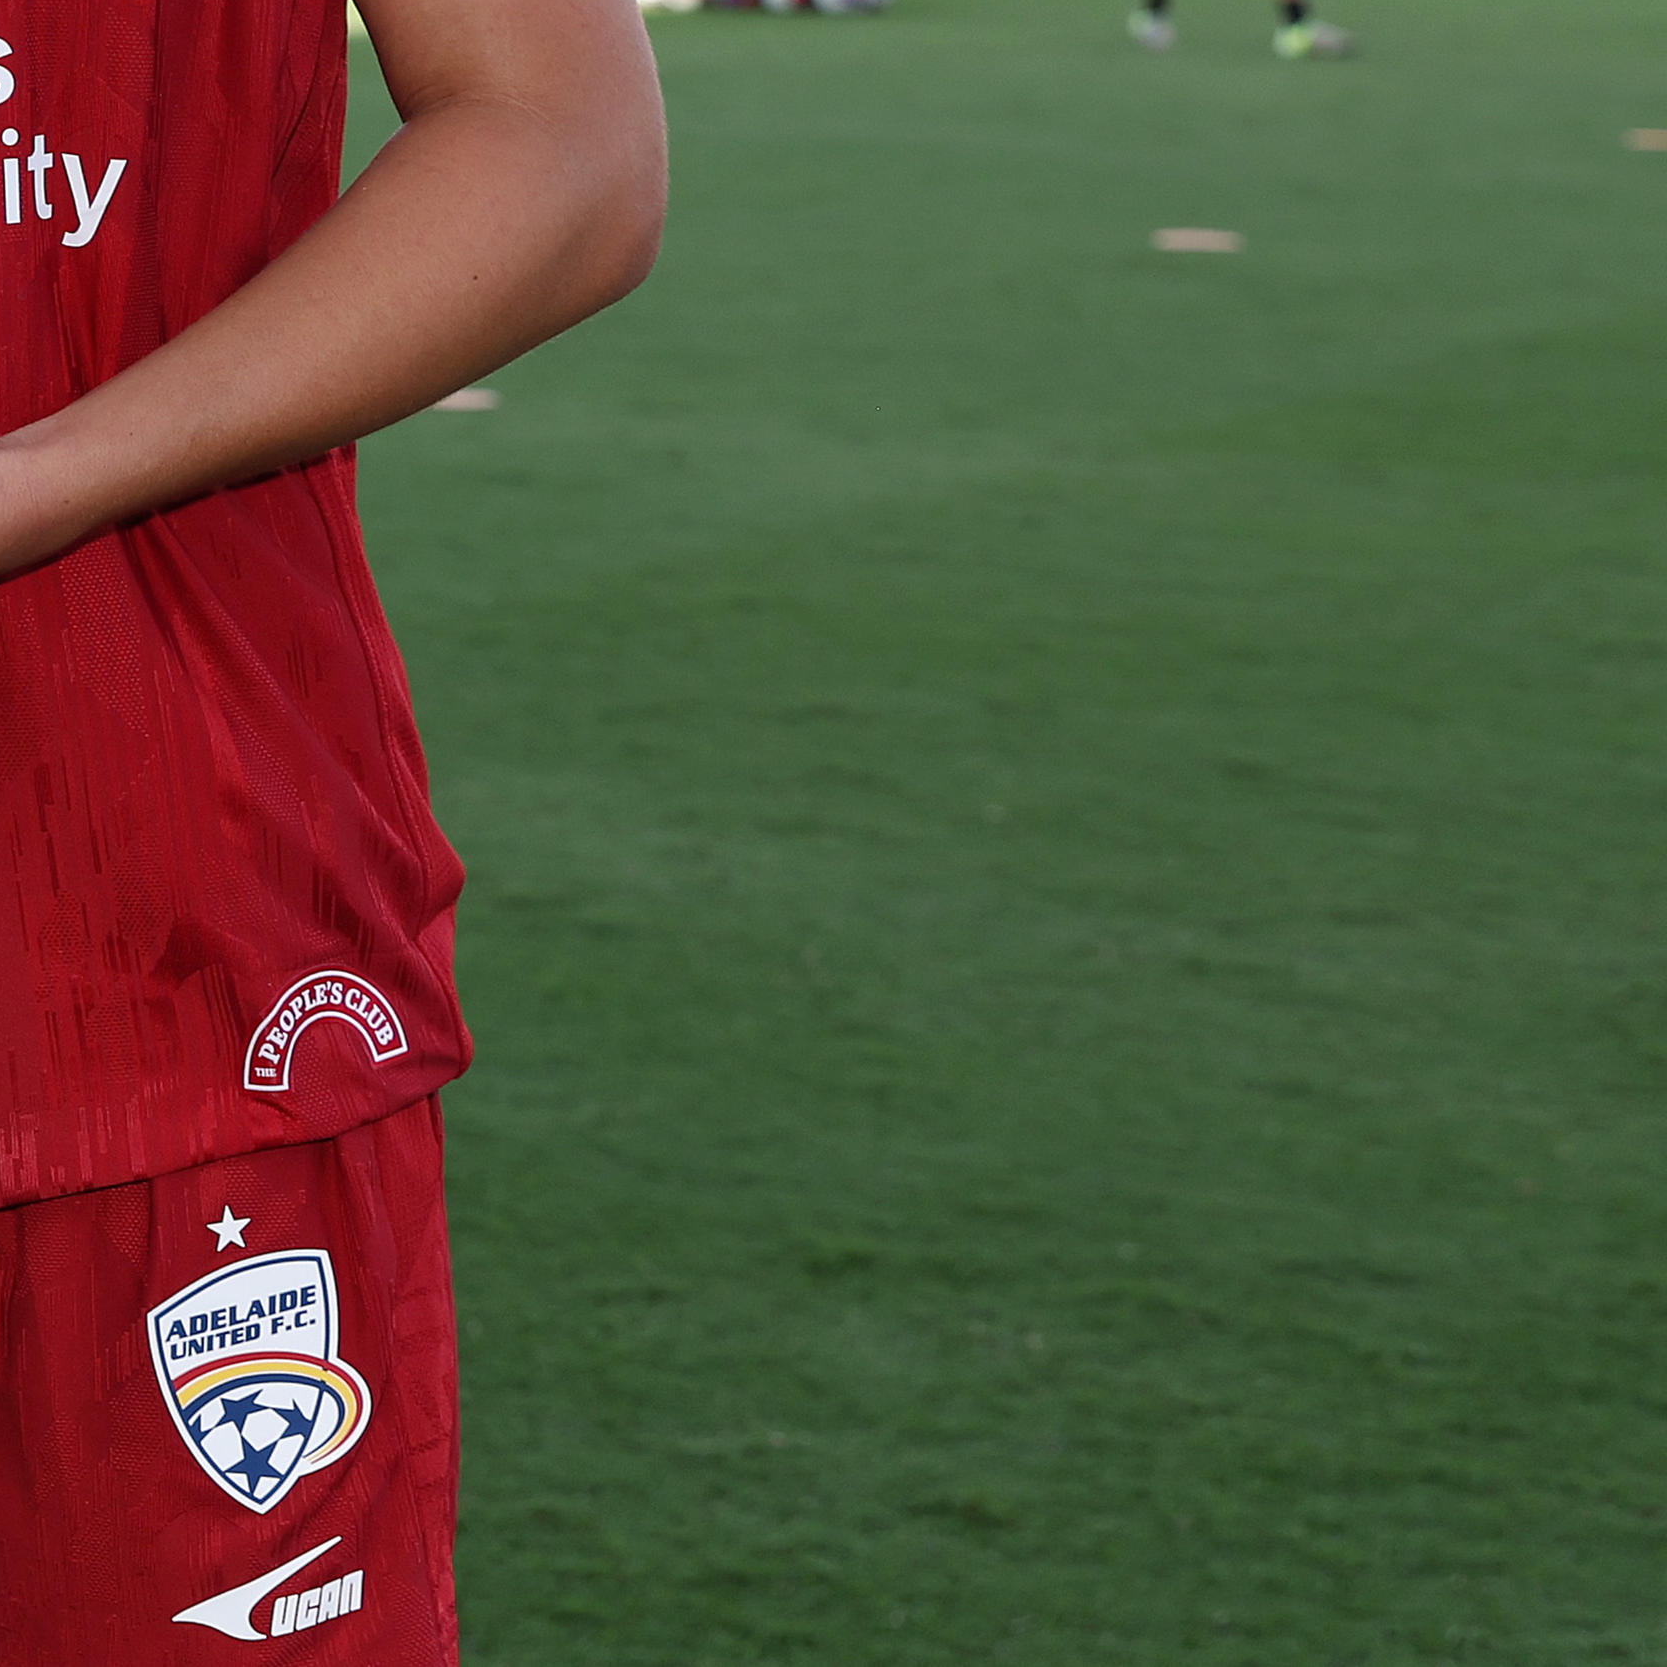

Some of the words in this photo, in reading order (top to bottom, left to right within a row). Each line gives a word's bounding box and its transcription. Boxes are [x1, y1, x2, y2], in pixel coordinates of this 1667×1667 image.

[258, 981, 343, 1065] PEOPLE'S
[345, 988, 395, 1046] CLUB
[254, 1067, 277, 1077] THE
[166, 1285, 316, 1342] ADELAIDE
[170, 1321, 261, 1361] UNITED
[271, 1309, 316, 1335] F.C.
